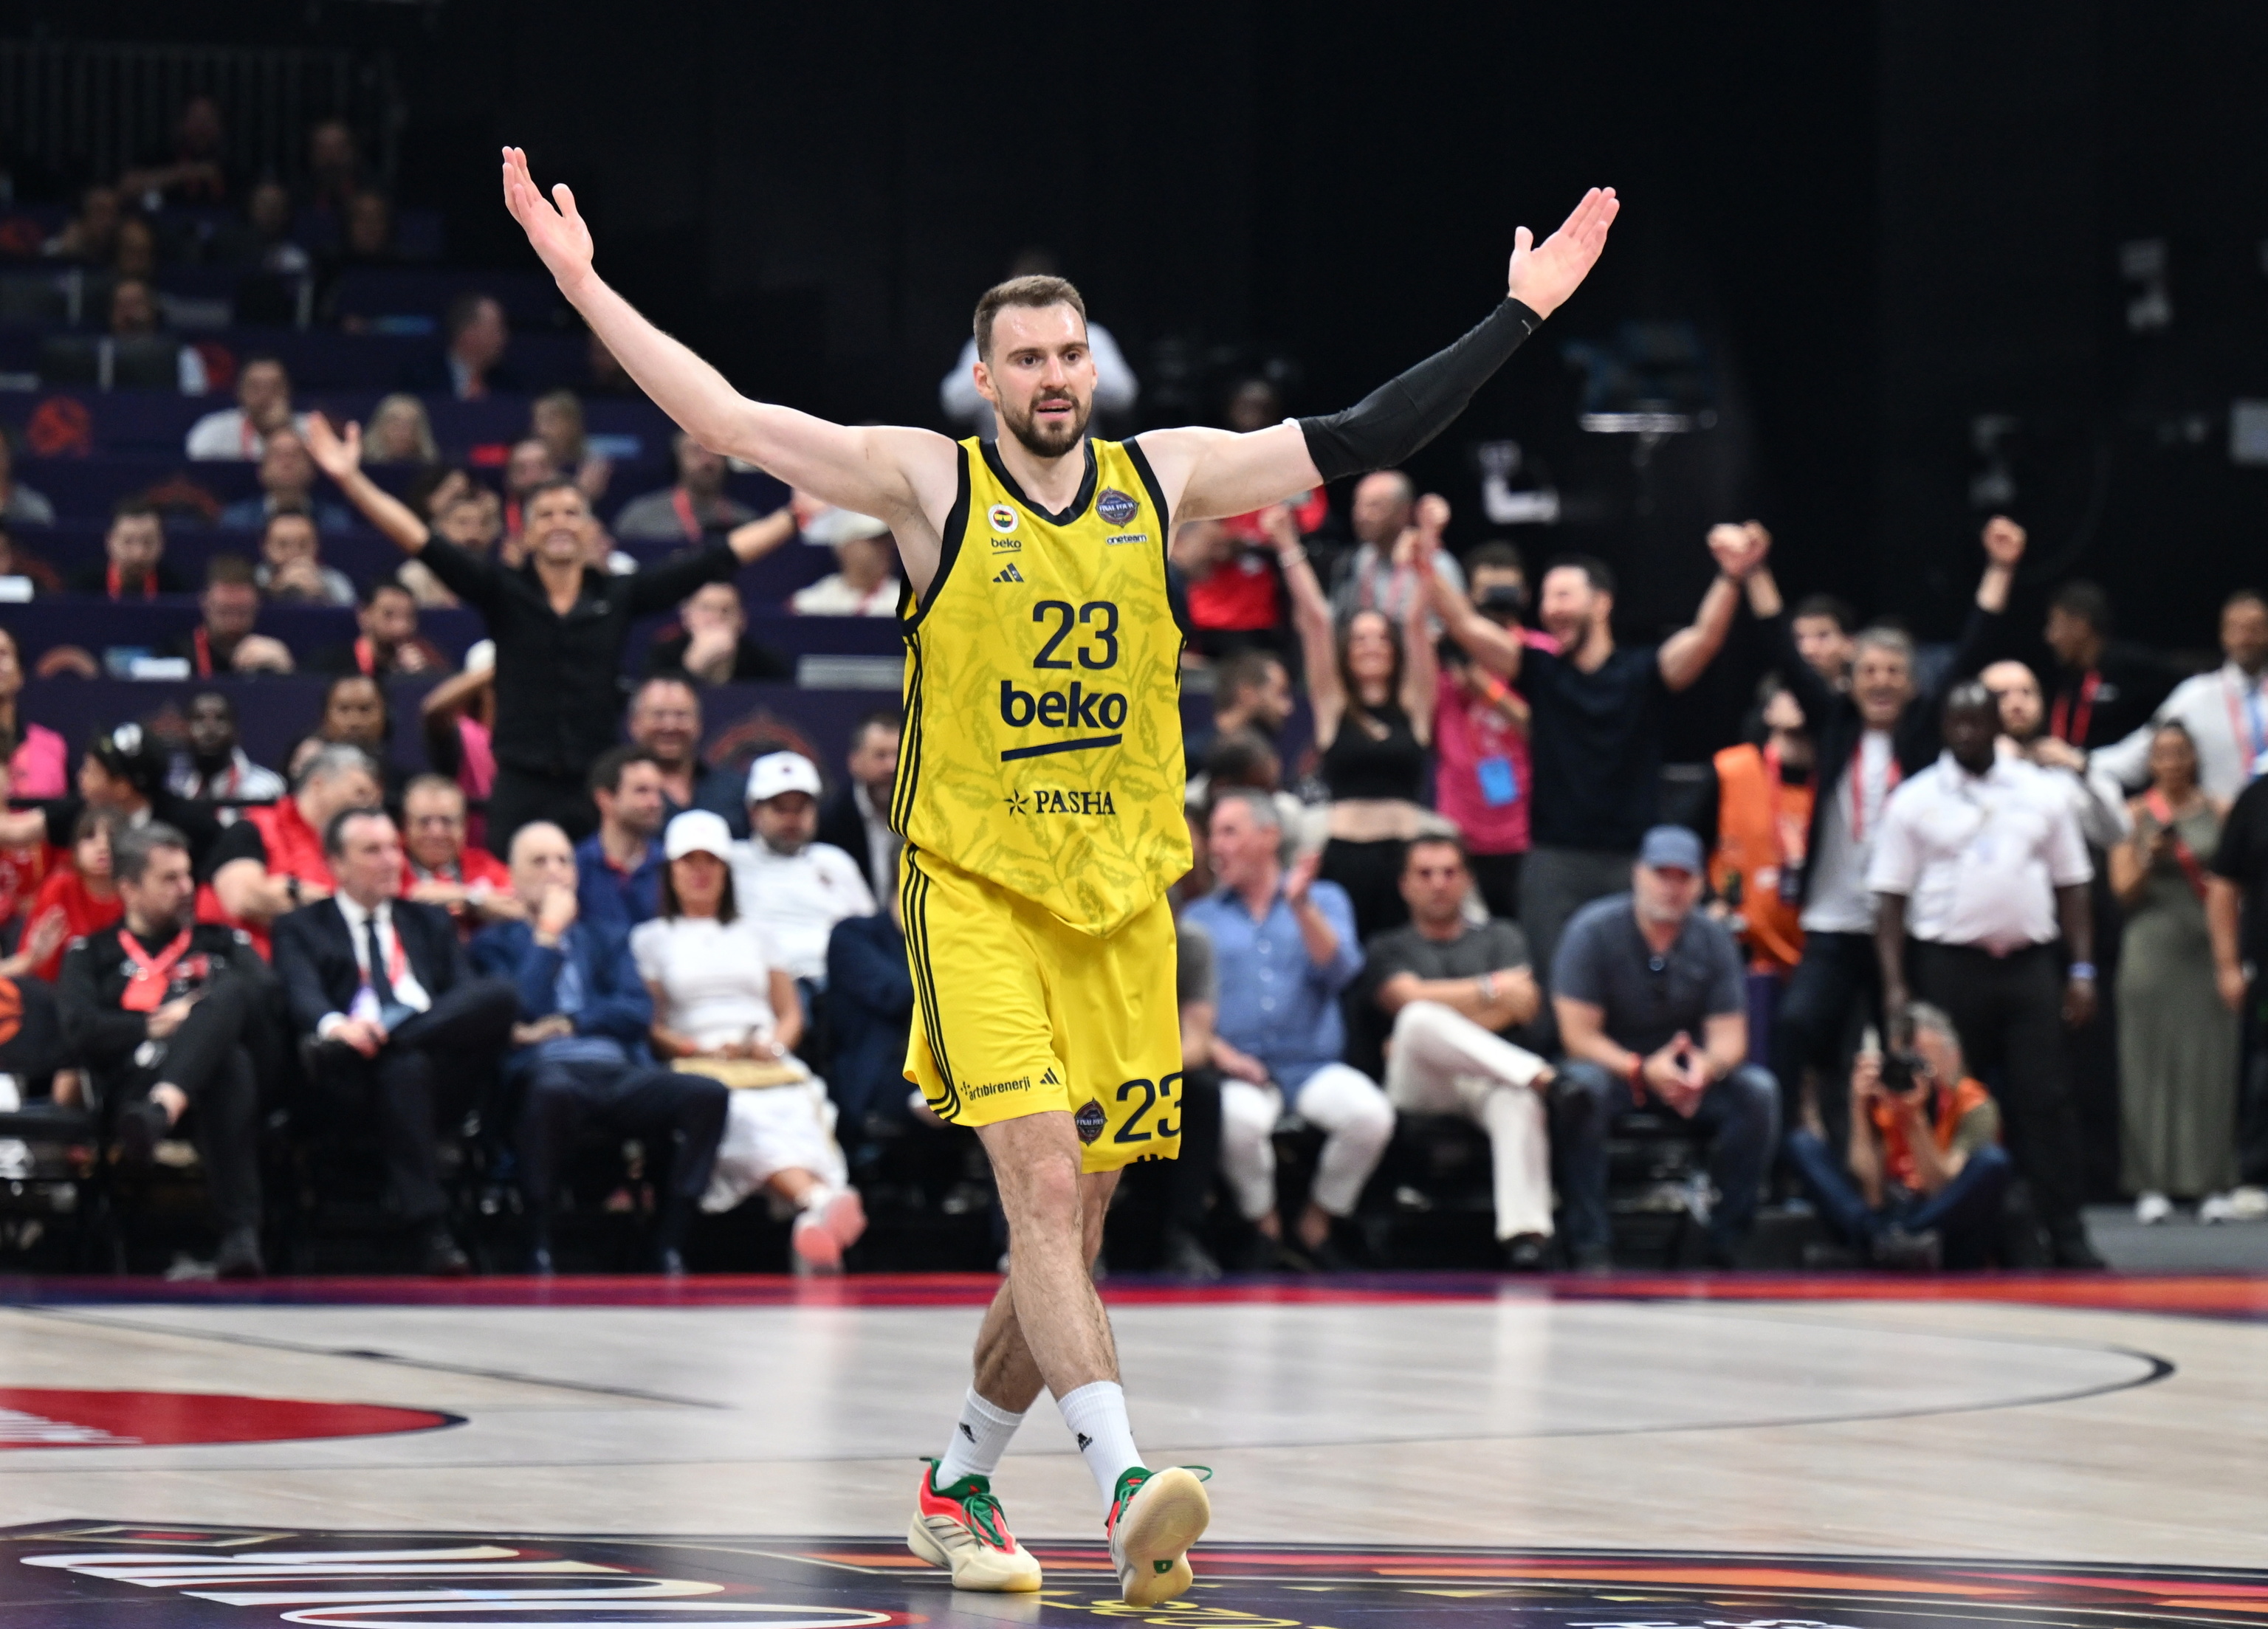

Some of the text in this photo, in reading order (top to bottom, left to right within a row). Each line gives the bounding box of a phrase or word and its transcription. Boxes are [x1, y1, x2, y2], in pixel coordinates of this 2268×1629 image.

[991, 537, 1022, 548] beko
[1107, 534, 1147, 544] oneteam
[1033, 600, 1118, 669] 23
[1000, 680, 1127, 729] beko
[1034, 790, 1116, 815] PASHA
[1113, 1070, 1182, 1144] 23
